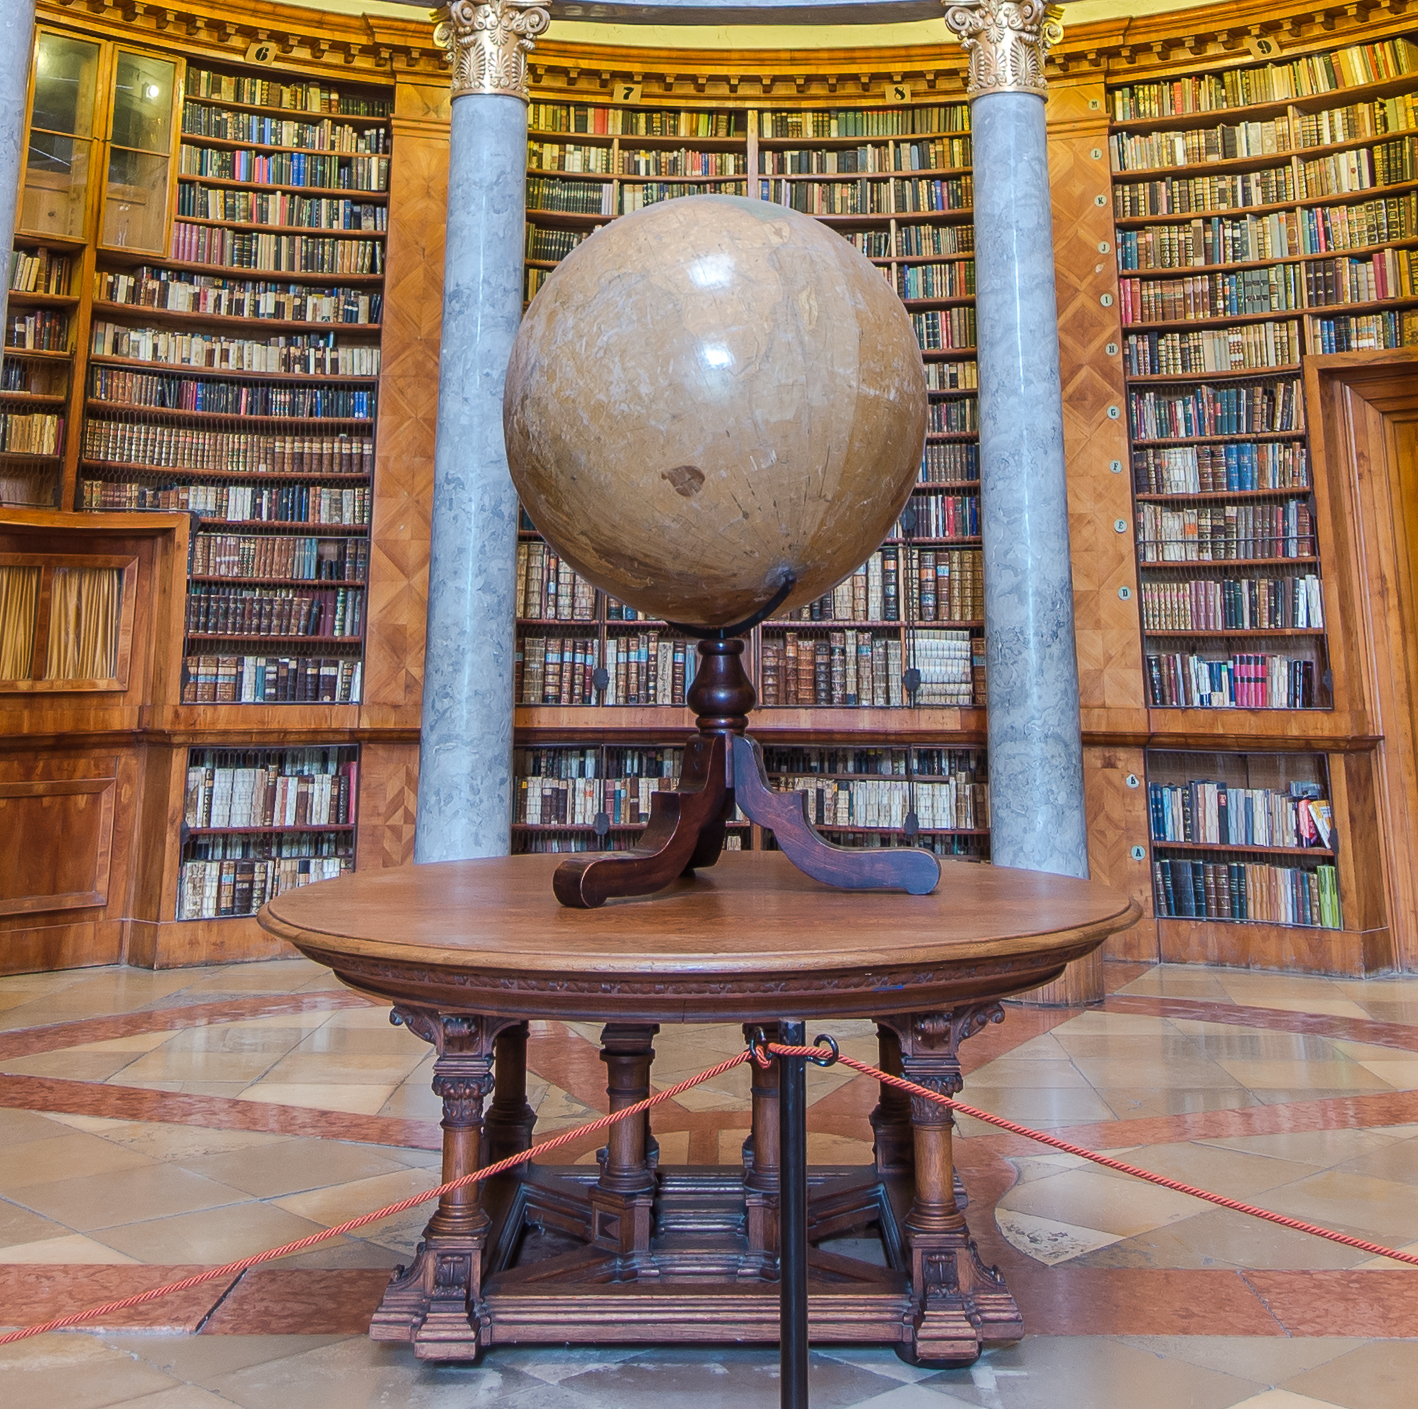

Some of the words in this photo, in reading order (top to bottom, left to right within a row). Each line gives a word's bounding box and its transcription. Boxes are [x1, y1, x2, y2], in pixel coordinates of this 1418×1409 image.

[1257, 40, 1272, 55] 9
[255, 46, 270, 62] 6
[622, 86, 634, 100] 7
[894, 86, 906, 101] 8
[1094, 150, 1100, 158] L
[1098, 197, 1104, 205] K
[1102, 244, 1106, 252] J
[1105, 296, 1108, 304] I
[1108, 345, 1115, 354] H
[1110, 408, 1116, 416] G
[1113, 462, 1119, 471] F
[1118, 521, 1124, 530] E
[1121, 588, 1128, 597] D
[1135, 848, 1142, 857] A
